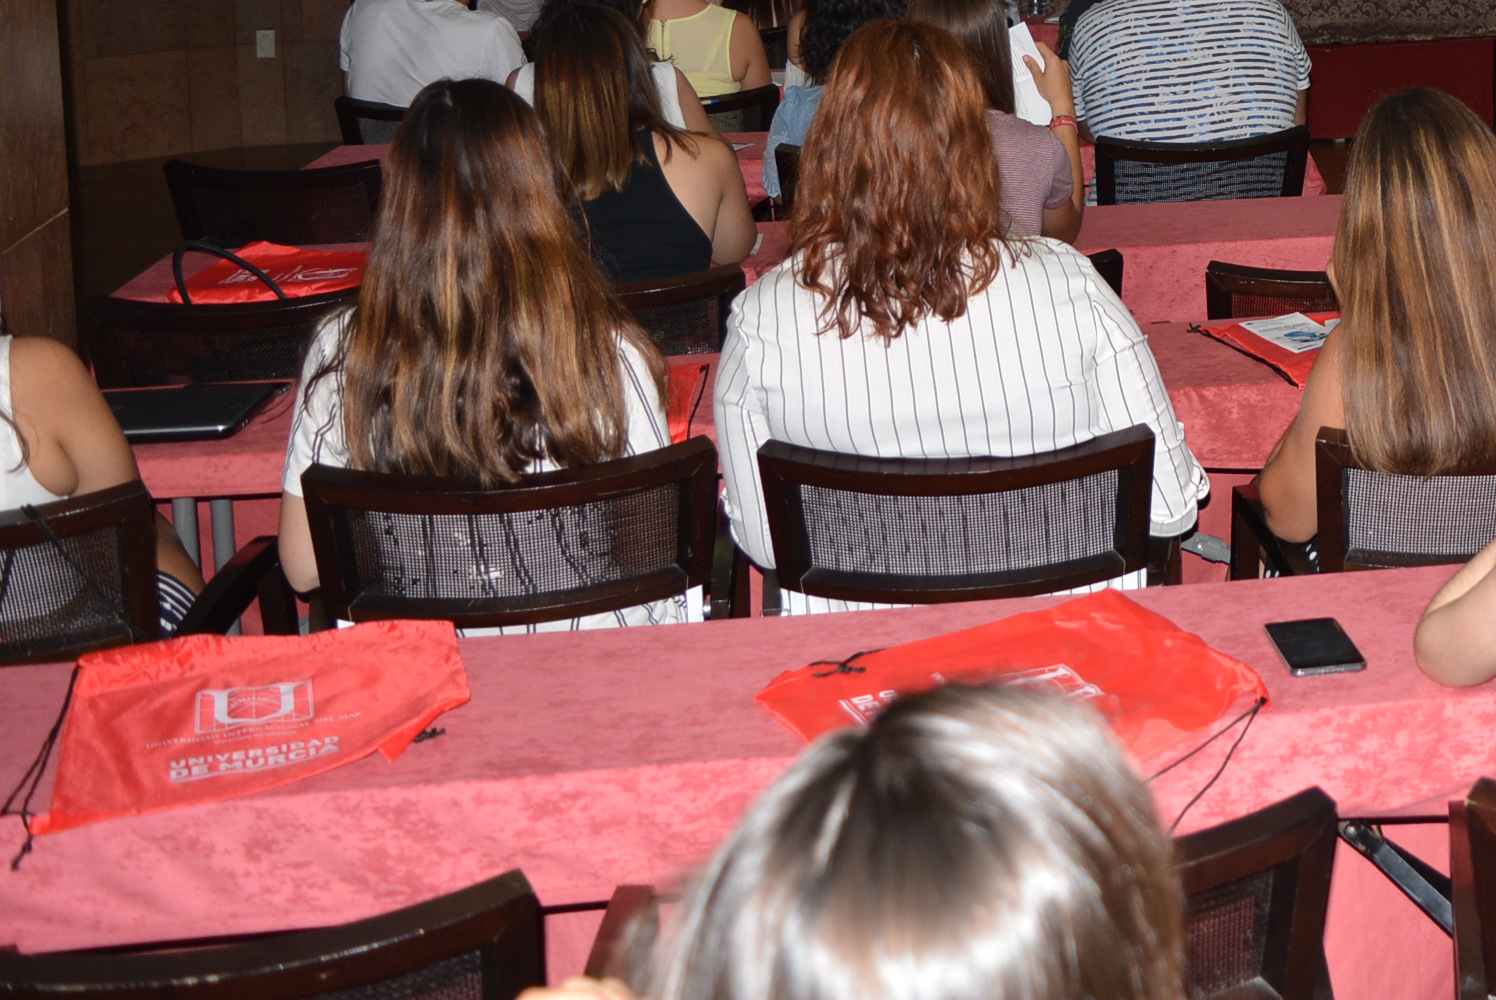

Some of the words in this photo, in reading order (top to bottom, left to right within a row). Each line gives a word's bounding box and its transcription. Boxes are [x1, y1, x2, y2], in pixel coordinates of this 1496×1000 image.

[169, 763, 209, 780] DE
[219, 744, 340, 771] MURCIA
[170, 736, 339, 769] UNIVERSIDAD
